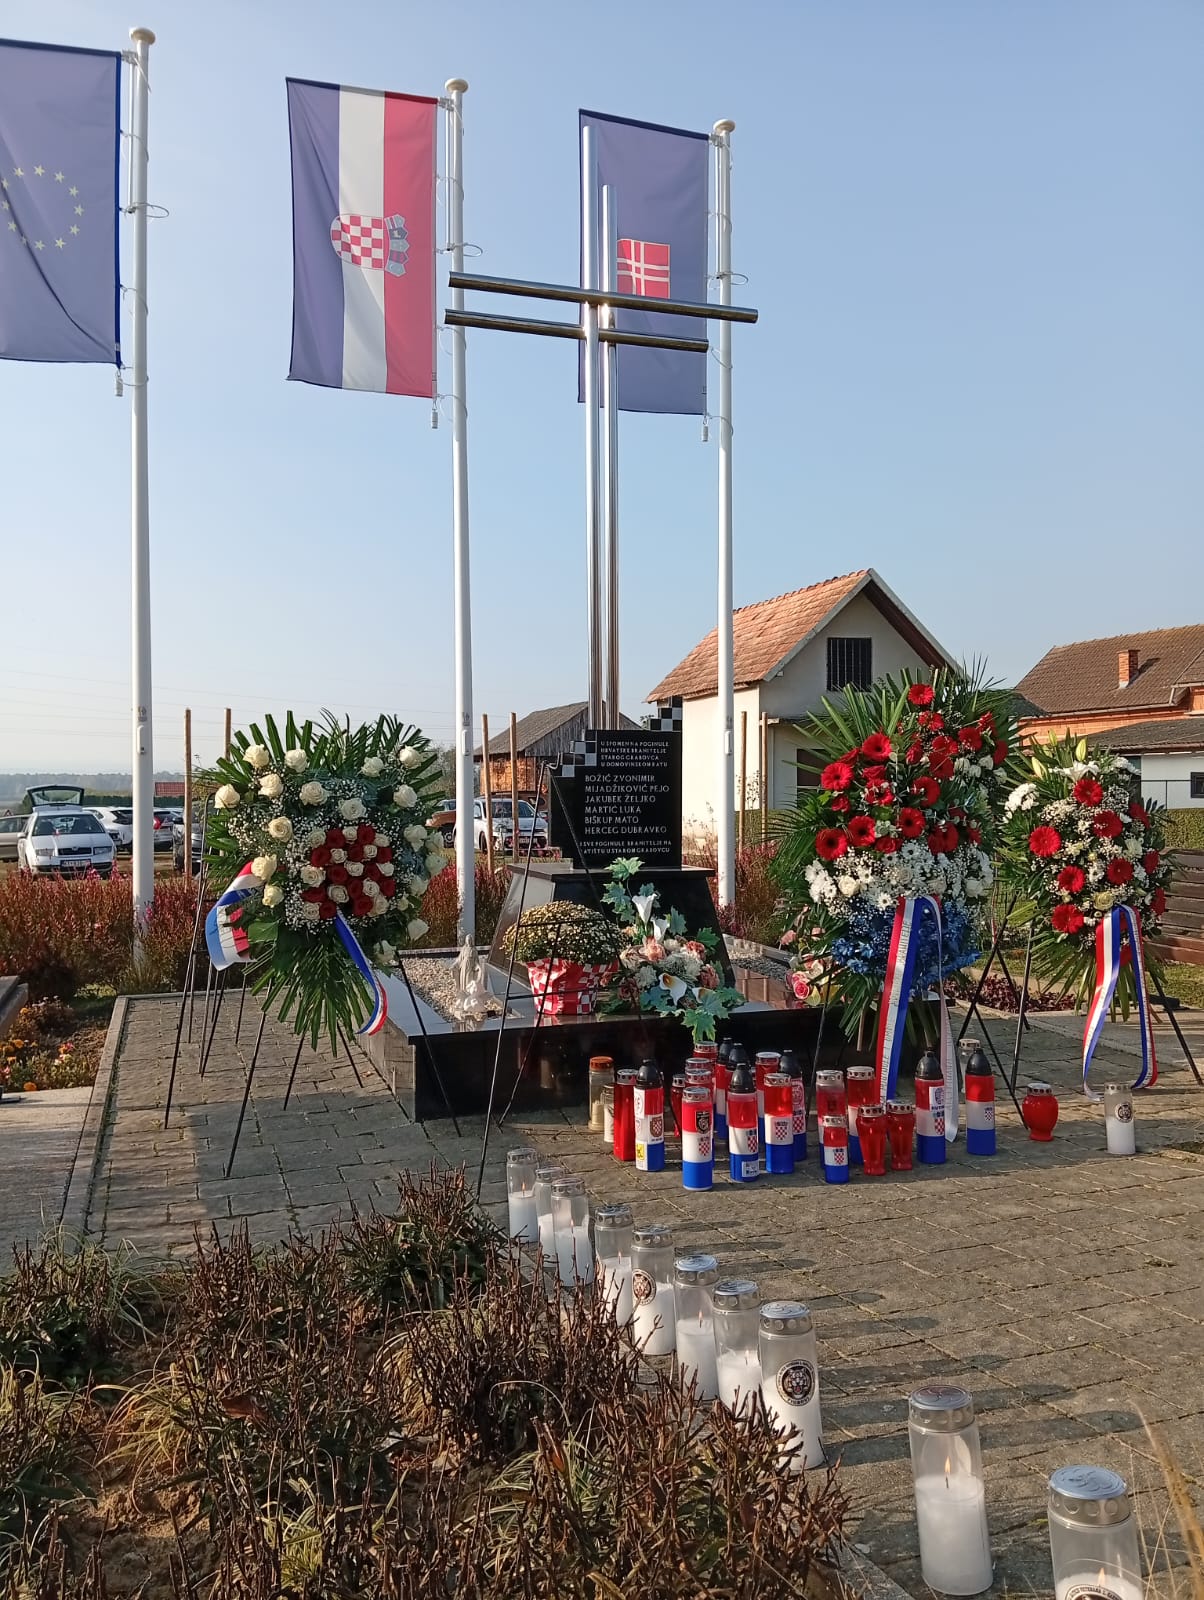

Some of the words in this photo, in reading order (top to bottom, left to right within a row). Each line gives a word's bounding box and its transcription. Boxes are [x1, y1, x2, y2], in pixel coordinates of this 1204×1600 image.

[613, 774, 655, 783] ZVONIMIR
[584, 783, 648, 793] MIJADŽIKOVIĆ
[650, 785, 670, 793] PEJO
[585, 795, 622, 803] JAKUBEK
[624, 794, 656, 803] ŽELJKO
[584, 805, 618, 814] MARTIĆ
[619, 805, 642, 814] LUKA
[584, 815, 613, 824] BIŠKUP
[614, 815, 639, 824] MATO
[584, 826, 619, 835] HERCEG
[621, 825, 667, 834] DUBRAVKO
